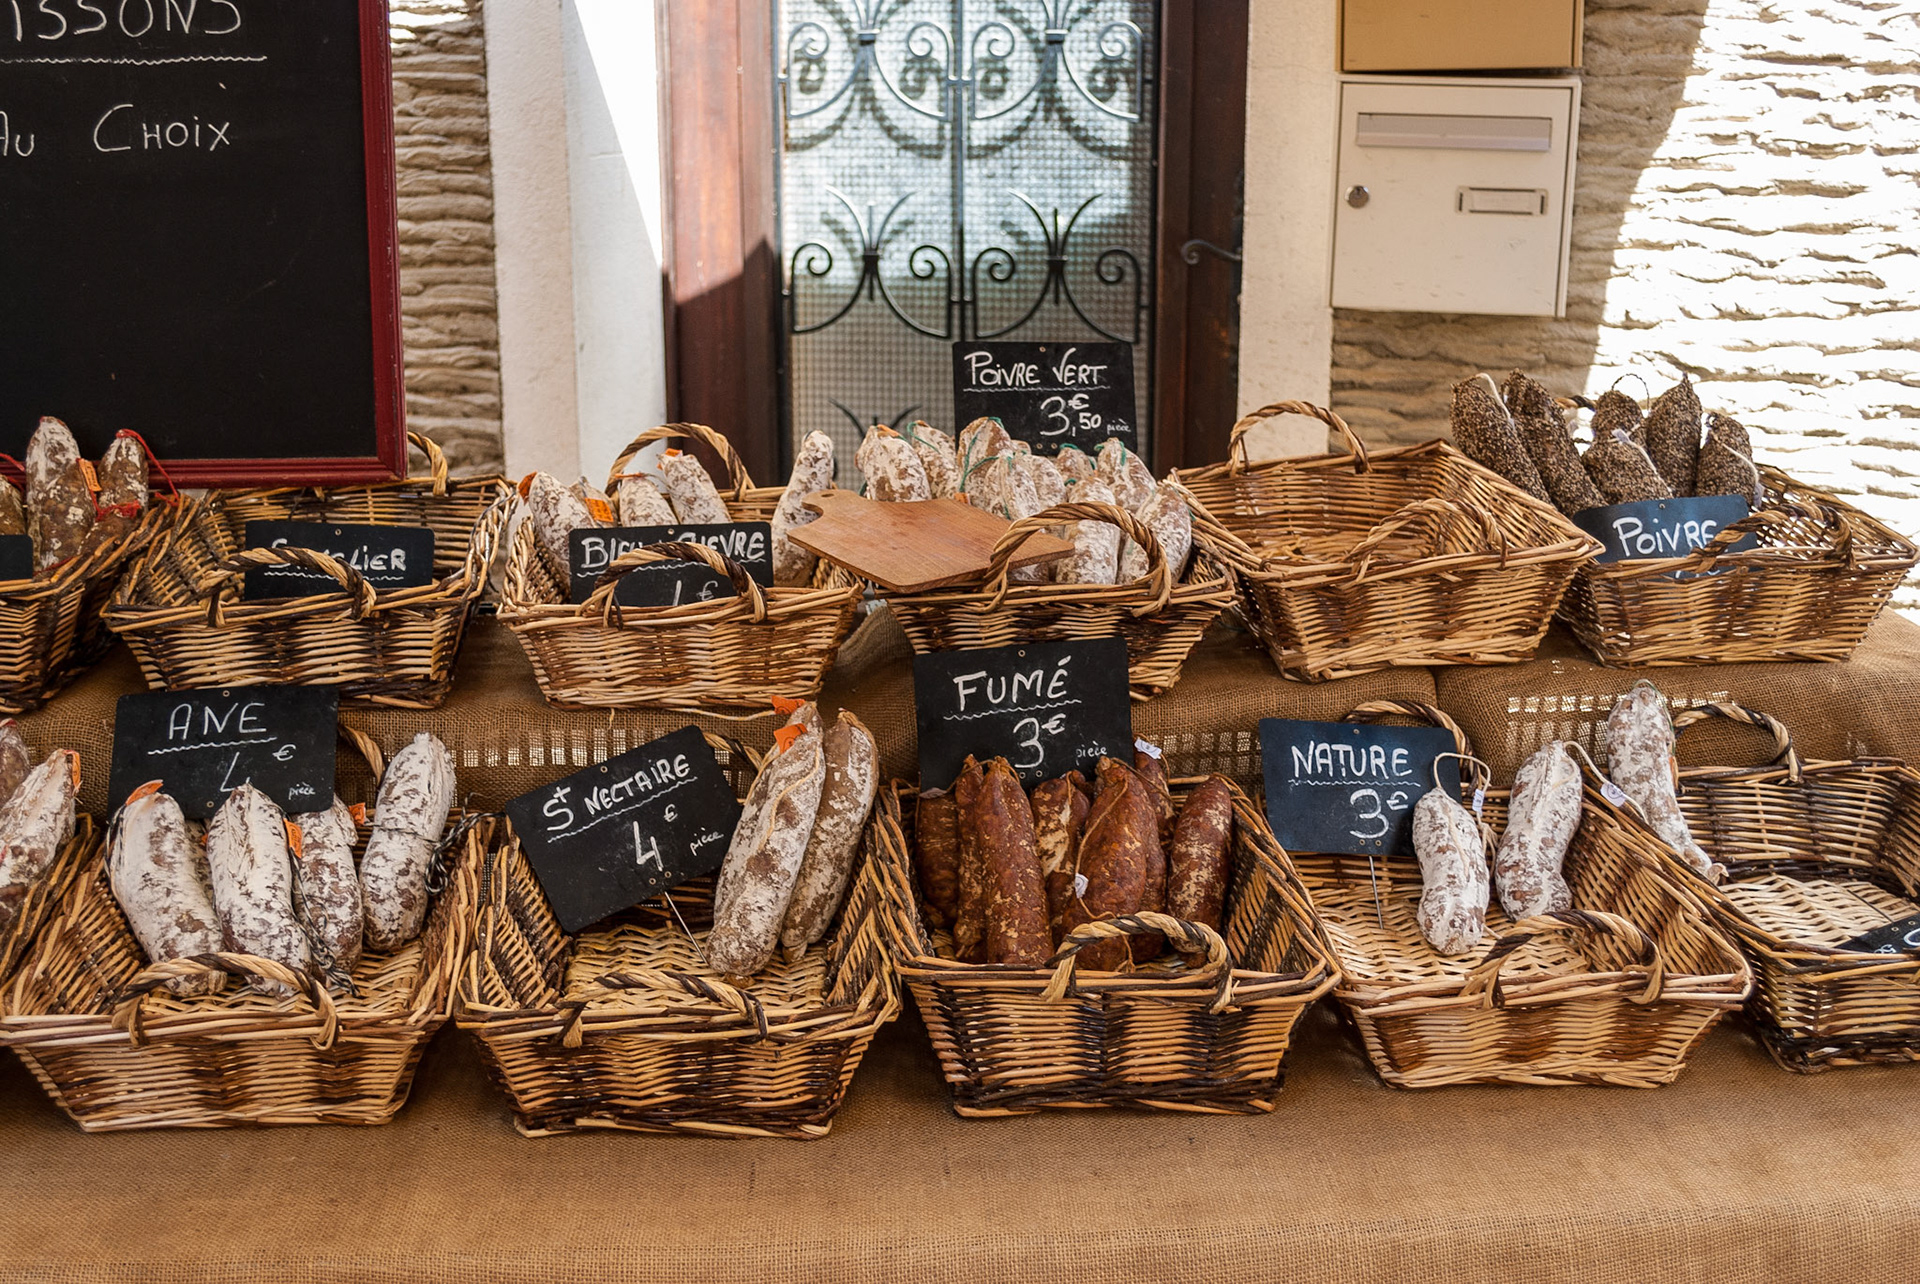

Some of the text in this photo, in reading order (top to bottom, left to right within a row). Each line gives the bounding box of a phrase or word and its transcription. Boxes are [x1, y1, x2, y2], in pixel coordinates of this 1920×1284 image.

[953, 655, 1072, 711] FUMÉ
[168, 702, 267, 740] ANE
[1291, 740, 1413, 780] NATURE
[584, 754, 691, 815] NECTAIRE
